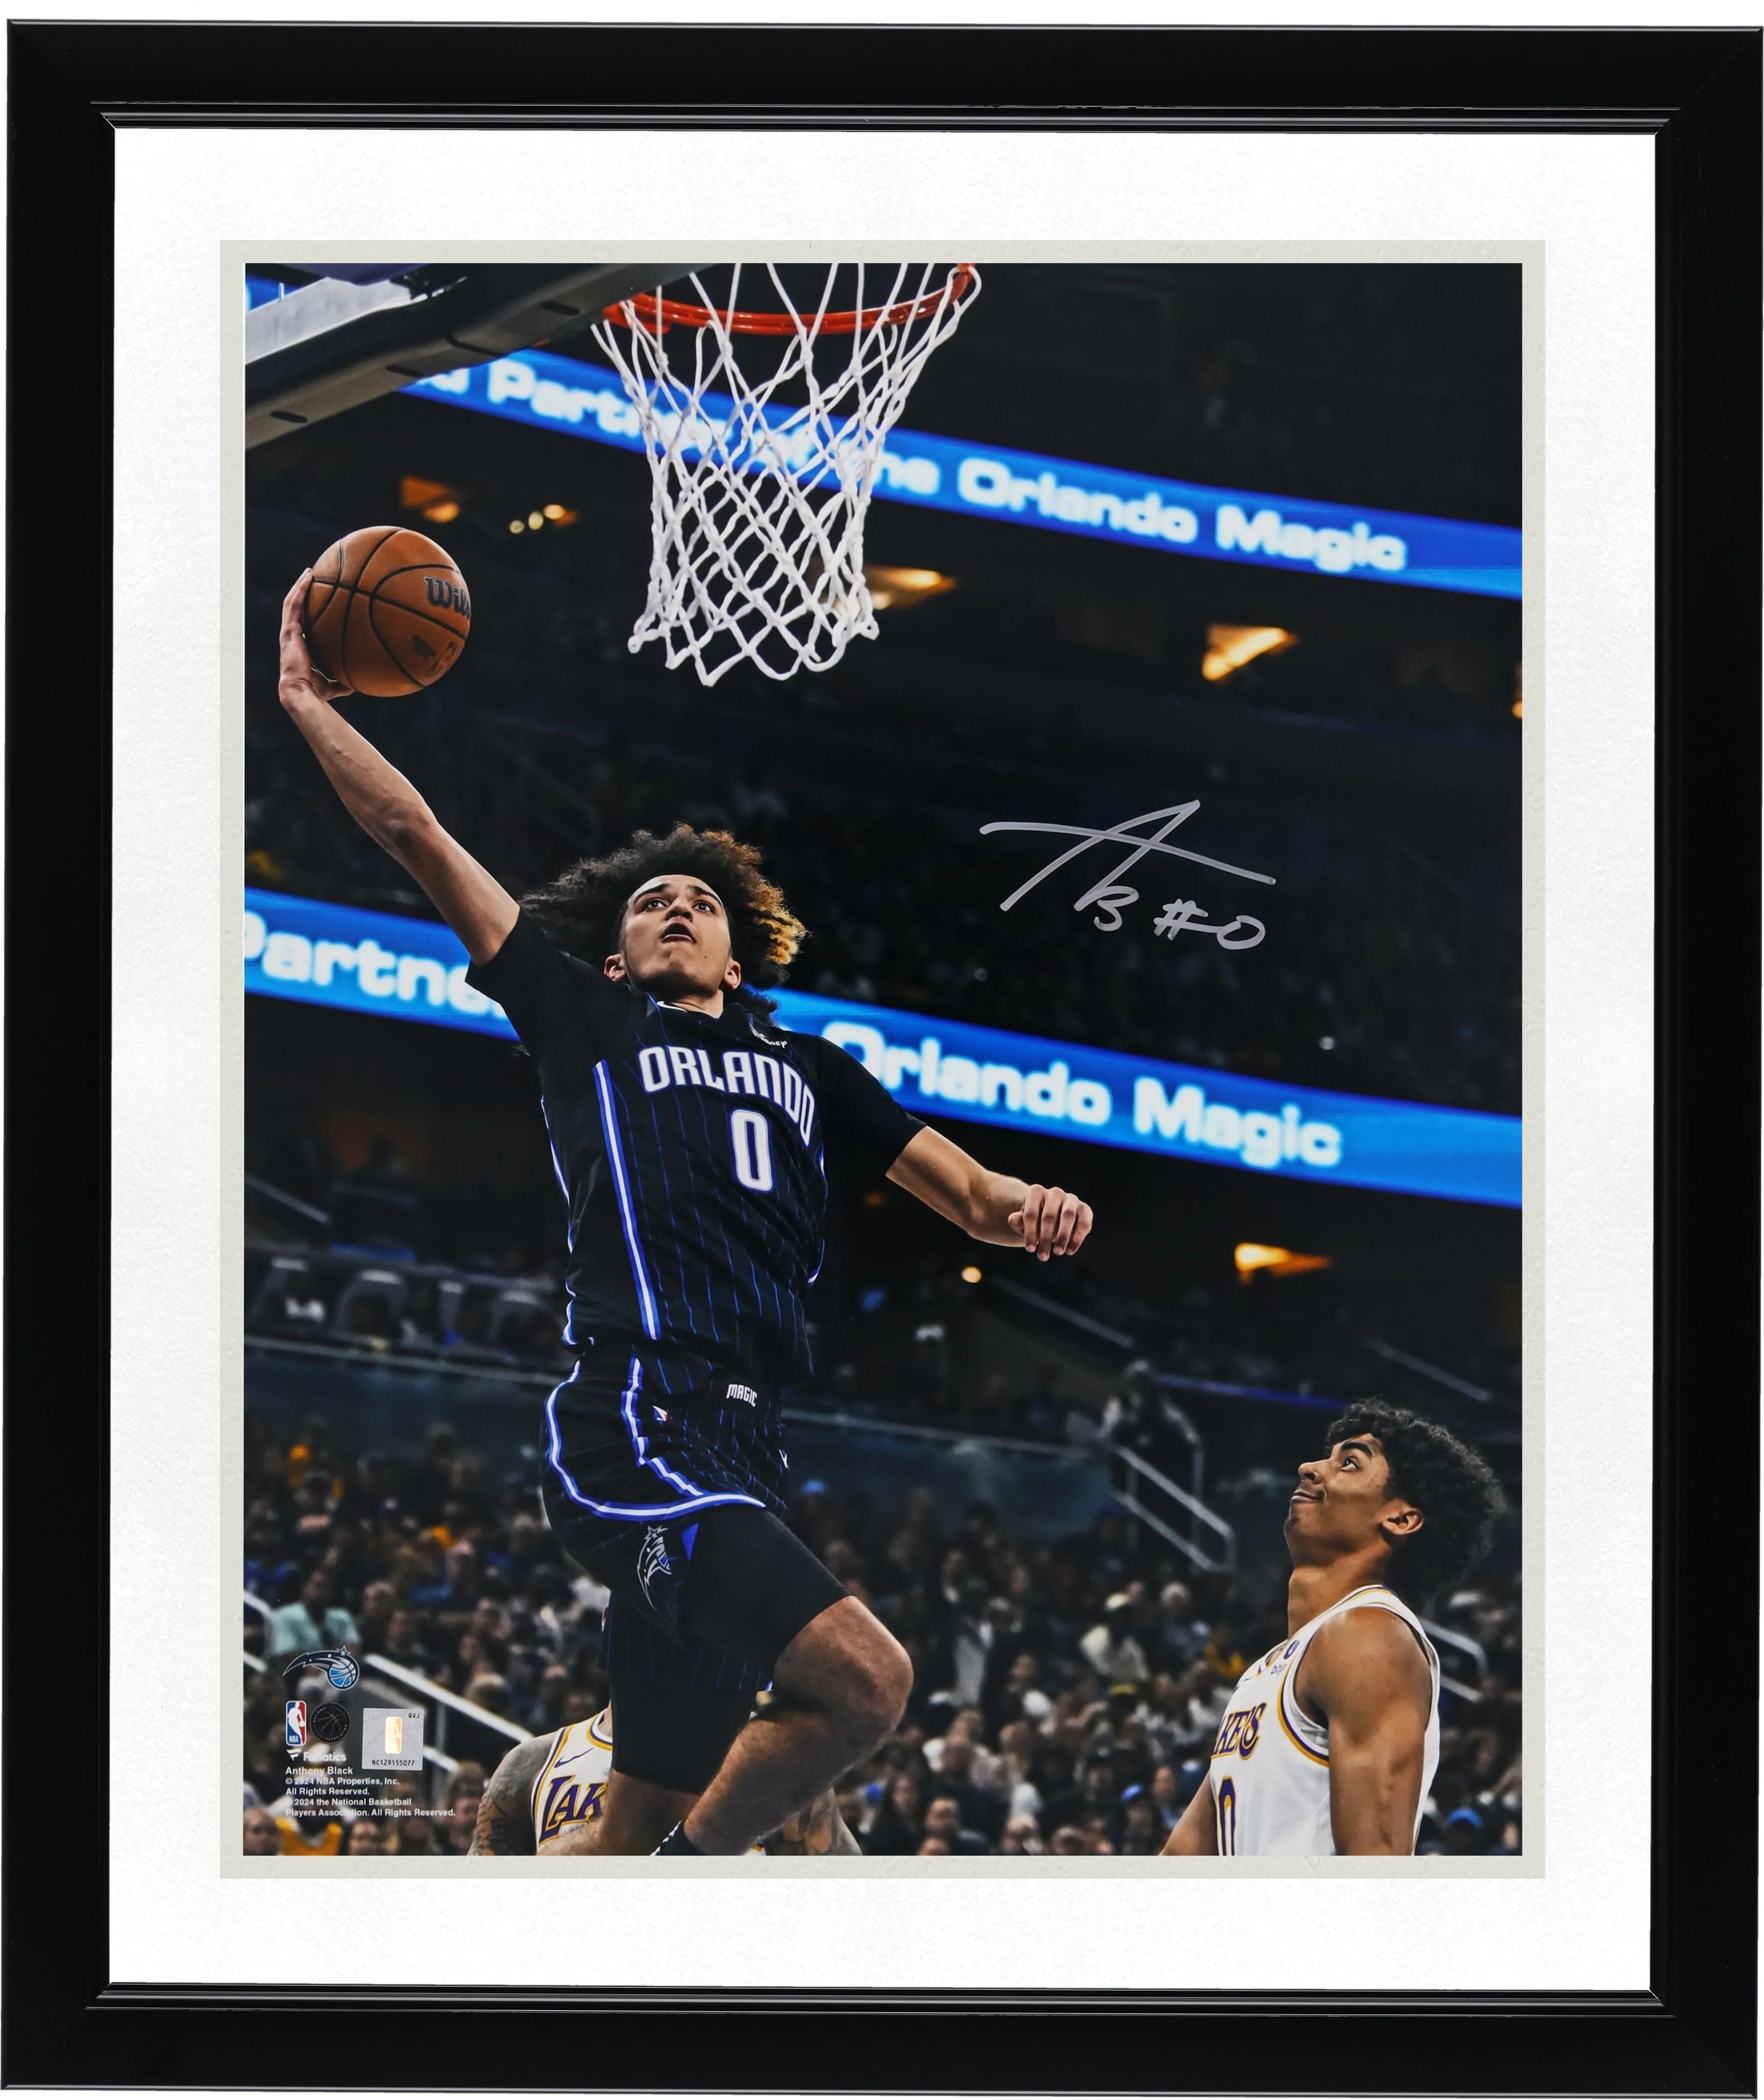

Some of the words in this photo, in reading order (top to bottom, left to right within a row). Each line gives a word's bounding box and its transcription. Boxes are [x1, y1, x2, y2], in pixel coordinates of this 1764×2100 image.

[958, 458, 1198, 543] Orlando
[1216, 504, 1407, 572] Magic
[639, 1046, 815, 1147] ORLANDO
[1133, 1076, 1342, 1168] Magic
[731, 1109, 774, 1192] 0
[726, 1384, 758, 1408] MAGIC
[285, 1766, 324, 1776] Anthony
[338, 1777, 383, 1786] Properties,
[299, 1787, 326, 1796] Rights
[286, 1809, 316, 1817] Players
[385, 1809, 412, 1817] Rights
